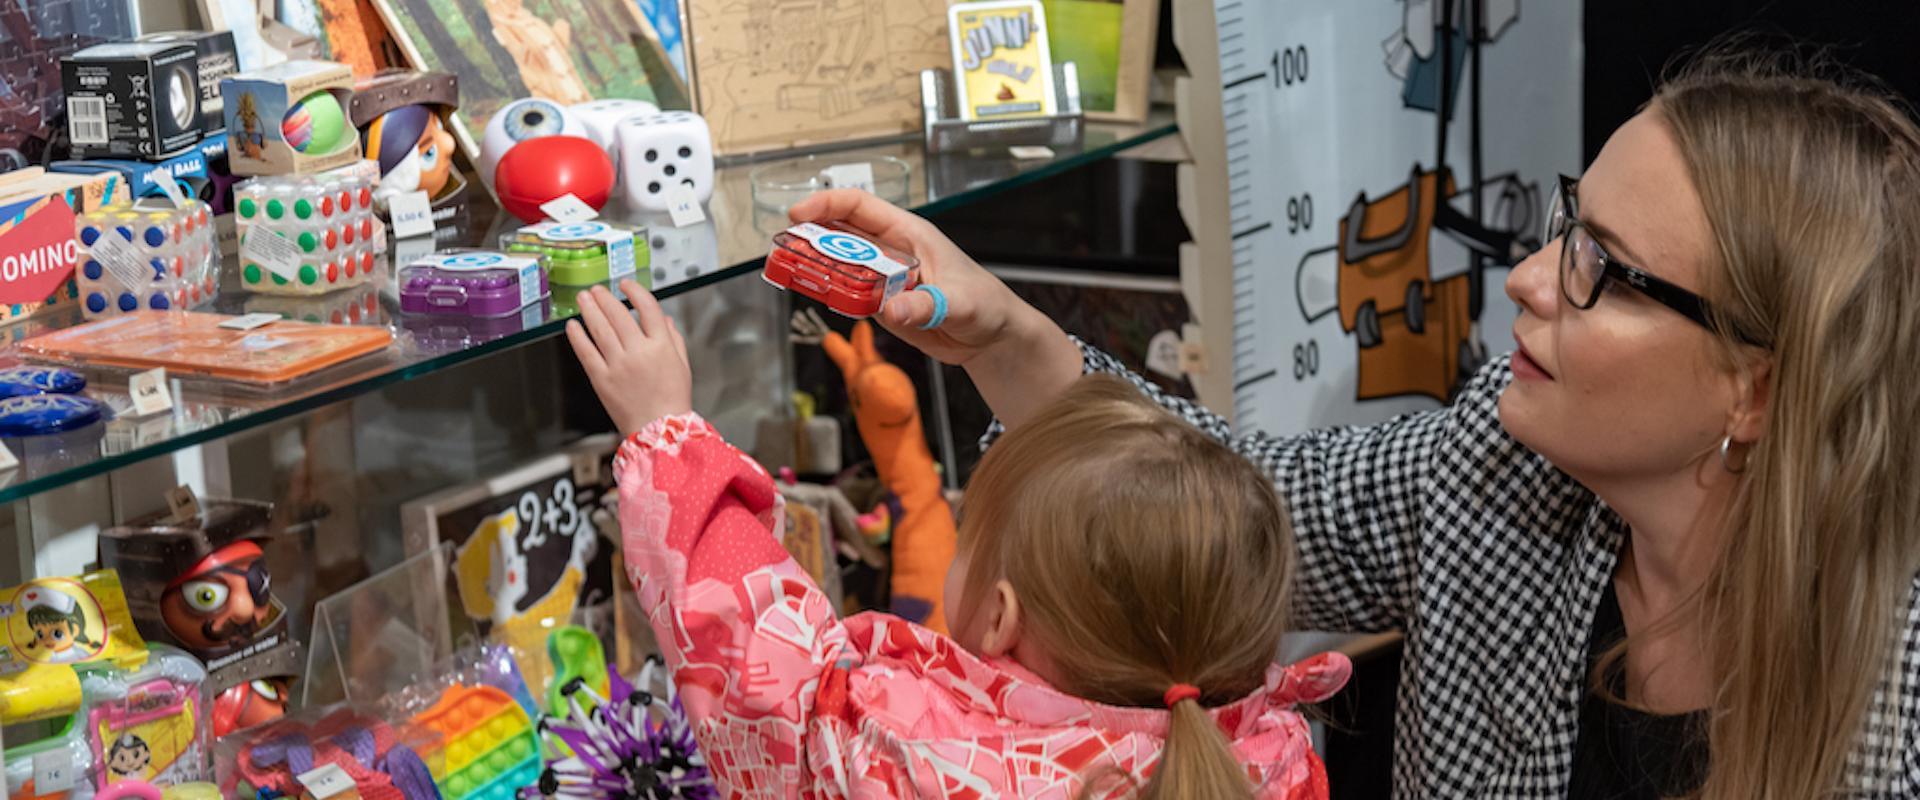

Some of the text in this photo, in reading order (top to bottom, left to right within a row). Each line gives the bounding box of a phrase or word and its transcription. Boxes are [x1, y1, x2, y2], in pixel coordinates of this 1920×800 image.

[1271, 44, 1308, 89] 100
[1287, 193, 1313, 235] 90
[0, 239, 78, 282] OMINO
[1293, 339, 1319, 381] 80
